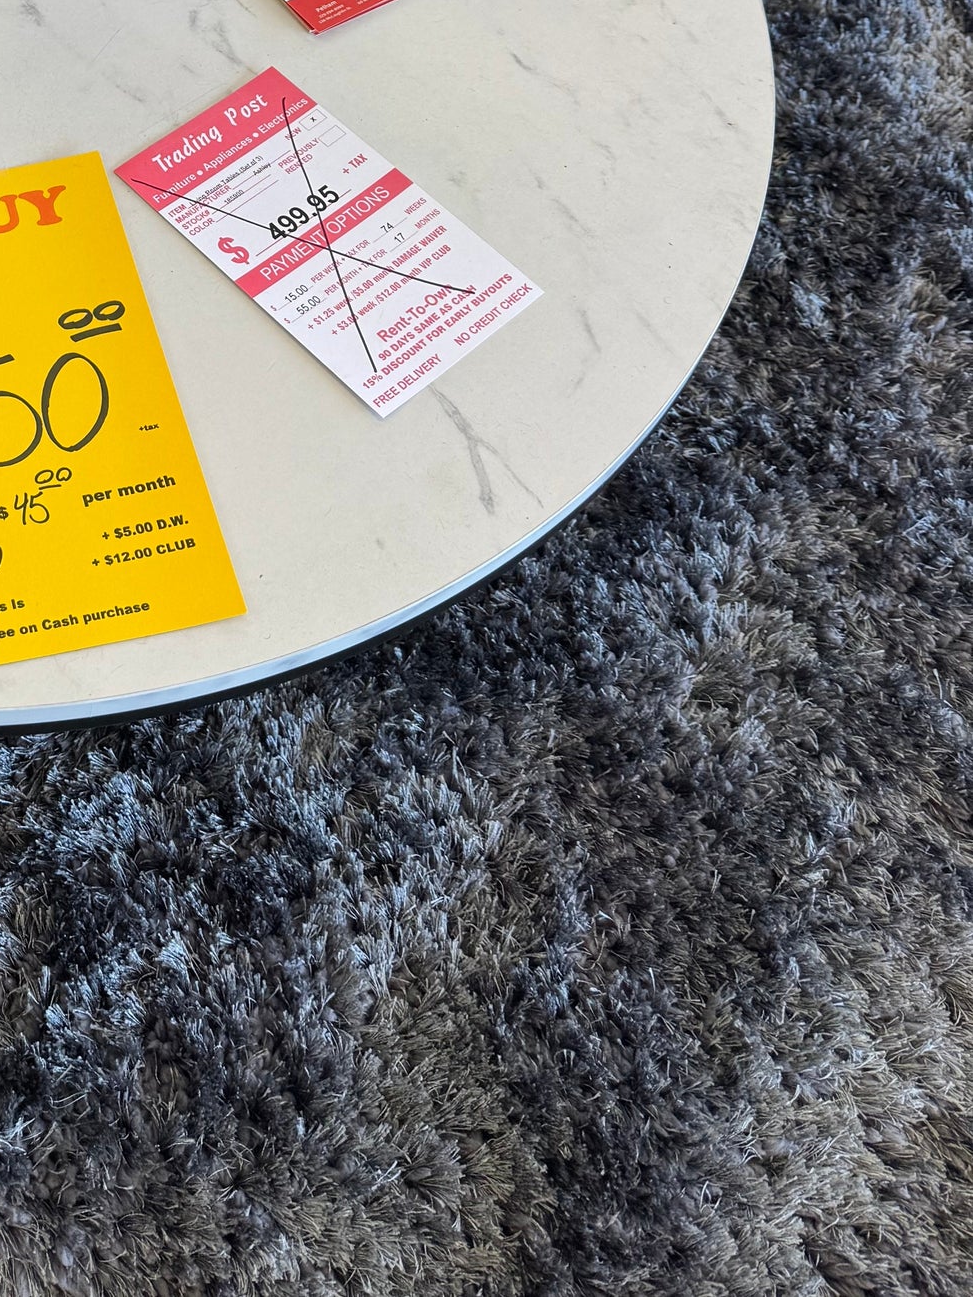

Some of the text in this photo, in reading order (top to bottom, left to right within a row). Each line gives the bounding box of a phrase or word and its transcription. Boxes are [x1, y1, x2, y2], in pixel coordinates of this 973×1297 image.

[151, 94, 268, 172] Trading Post
[152, 98, 309, 204] Furniture Appliances Electronics
[347, 153, 368, 169] TAX
[167, 203, 188, 218] ITEM
[188, 217, 217, 236] COLOR
[217, 184, 342, 265] $ 499.95
[259, 186, 390, 281] PAYMENT OPTIONS
[284, 197, 427, 303] 15.00 74 WEEKS
[295, 208, 441, 315] 55.00 17 MONTHS
[391, 225, 448, 268] DAMAGE WAIVER
[418, 244, 452, 269] VIP CLUB
[362, 273, 513, 389] 15% DISCOUNT FOR EARLY BUYOUTS
[376, 283, 458, 343] Rent-To-Own
[378, 284, 477, 361] 90 DAYS SAME AS CASH
[453, 282, 533, 347] NO CREDIT CHECK
[372, 353, 442, 408] FREE DELIVERY
[138, 423, 160, 432] +tax
[82, 489, 113, 508] per
[117, 475, 176, 497] month
[113, 514, 189, 539] $5.00 D.W.
[104, 538, 196, 566] $12.00 CLUB
[11, 598, 26, 610] Is
[19, 624, 38, 635] on
[41, 614, 79, 631] Cash
[82, 602, 150, 625] purchase
